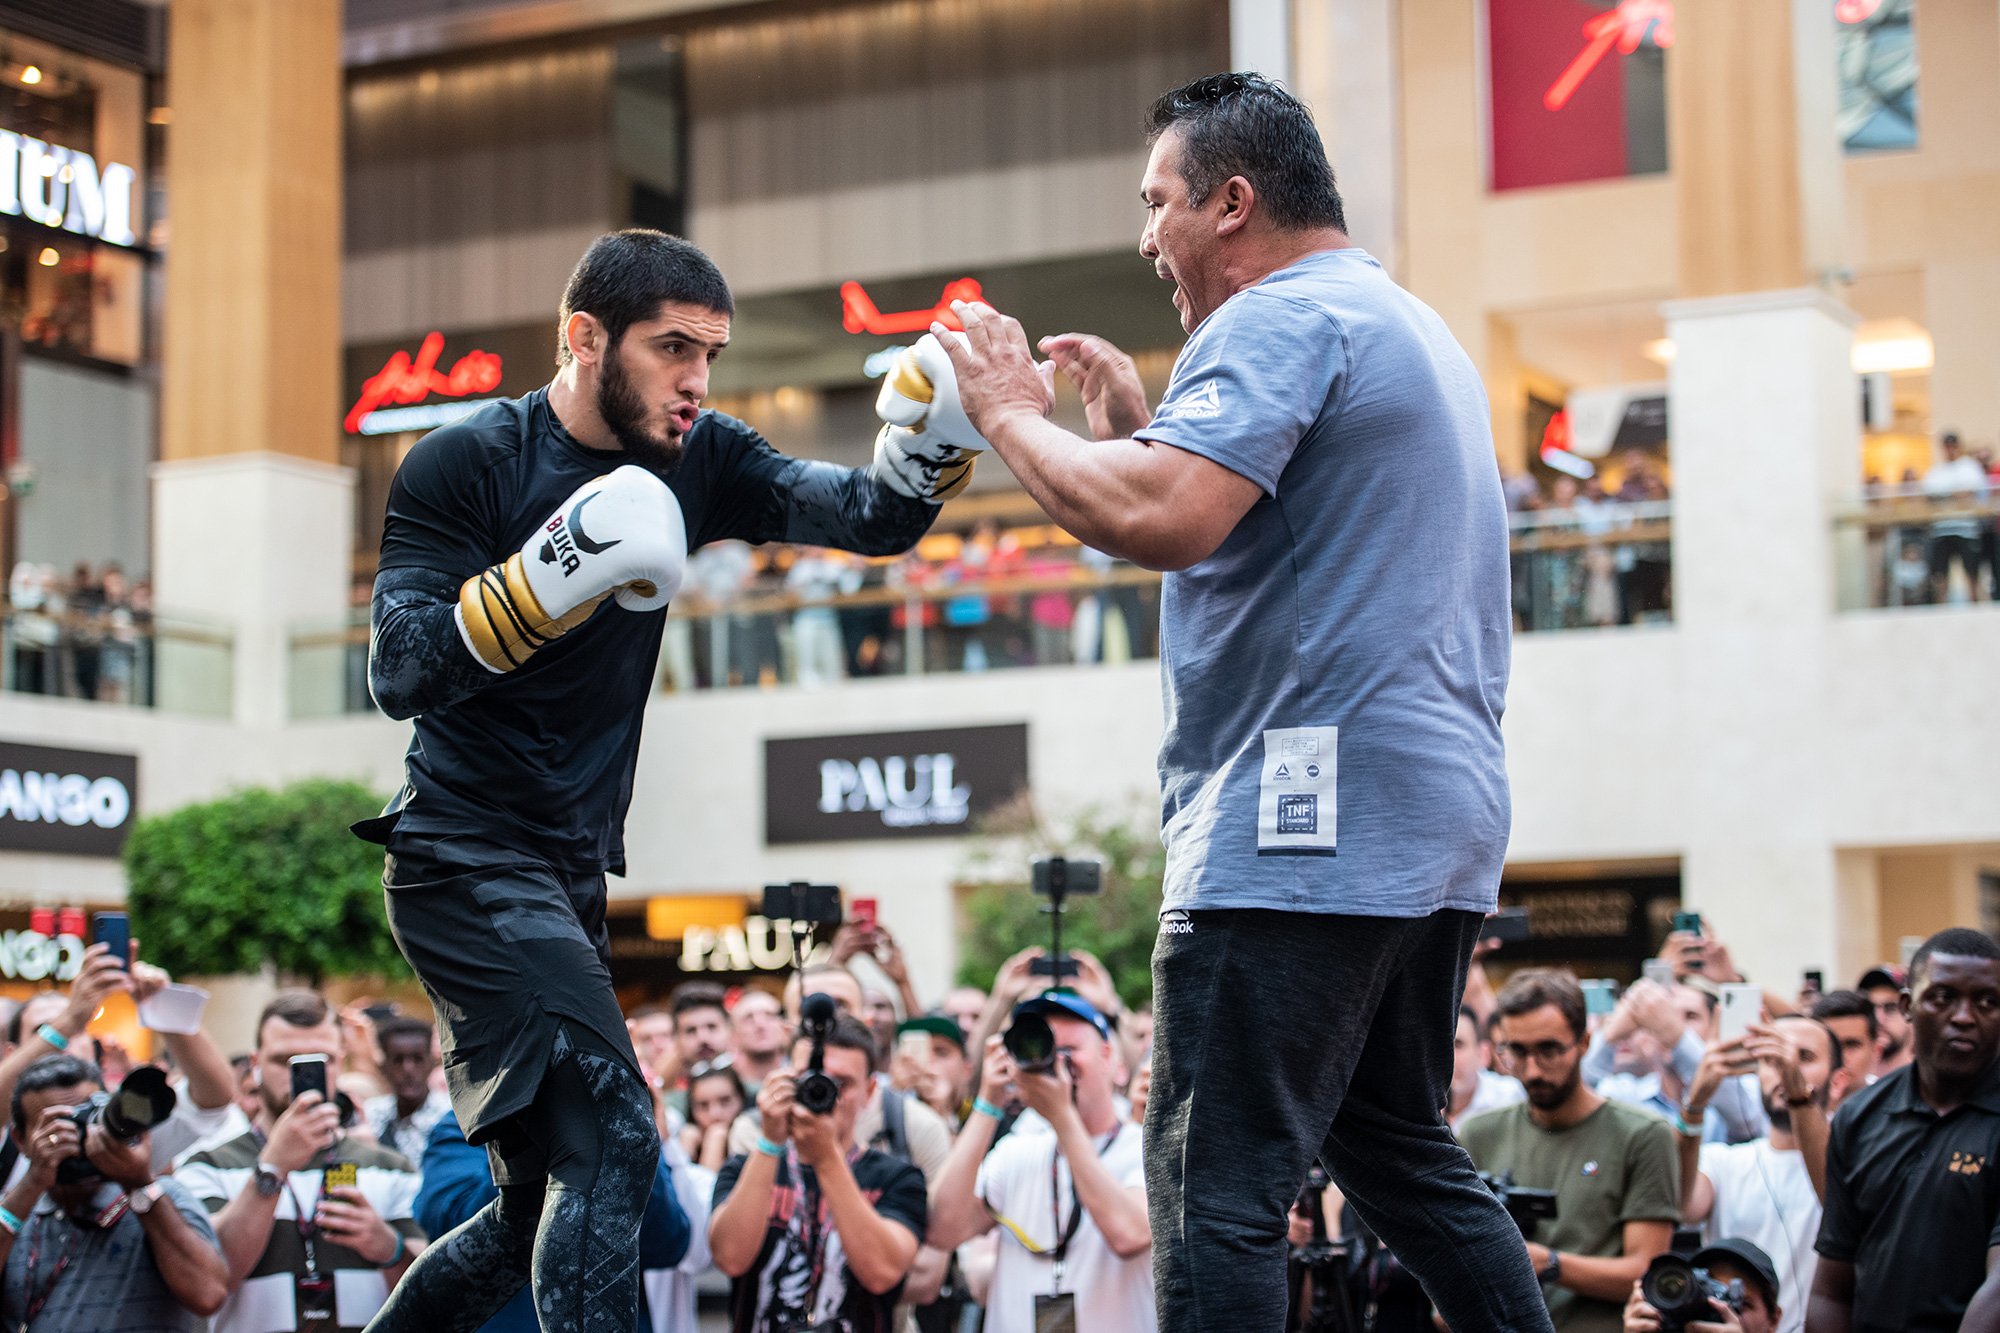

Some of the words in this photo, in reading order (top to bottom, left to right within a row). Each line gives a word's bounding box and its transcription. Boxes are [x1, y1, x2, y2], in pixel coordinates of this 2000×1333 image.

[545, 514, 581, 578] BUKA
[817, 753, 972, 814] PAUL
[1286, 804, 1310, 817] TNF
[1161, 920, 1194, 934] eebok
